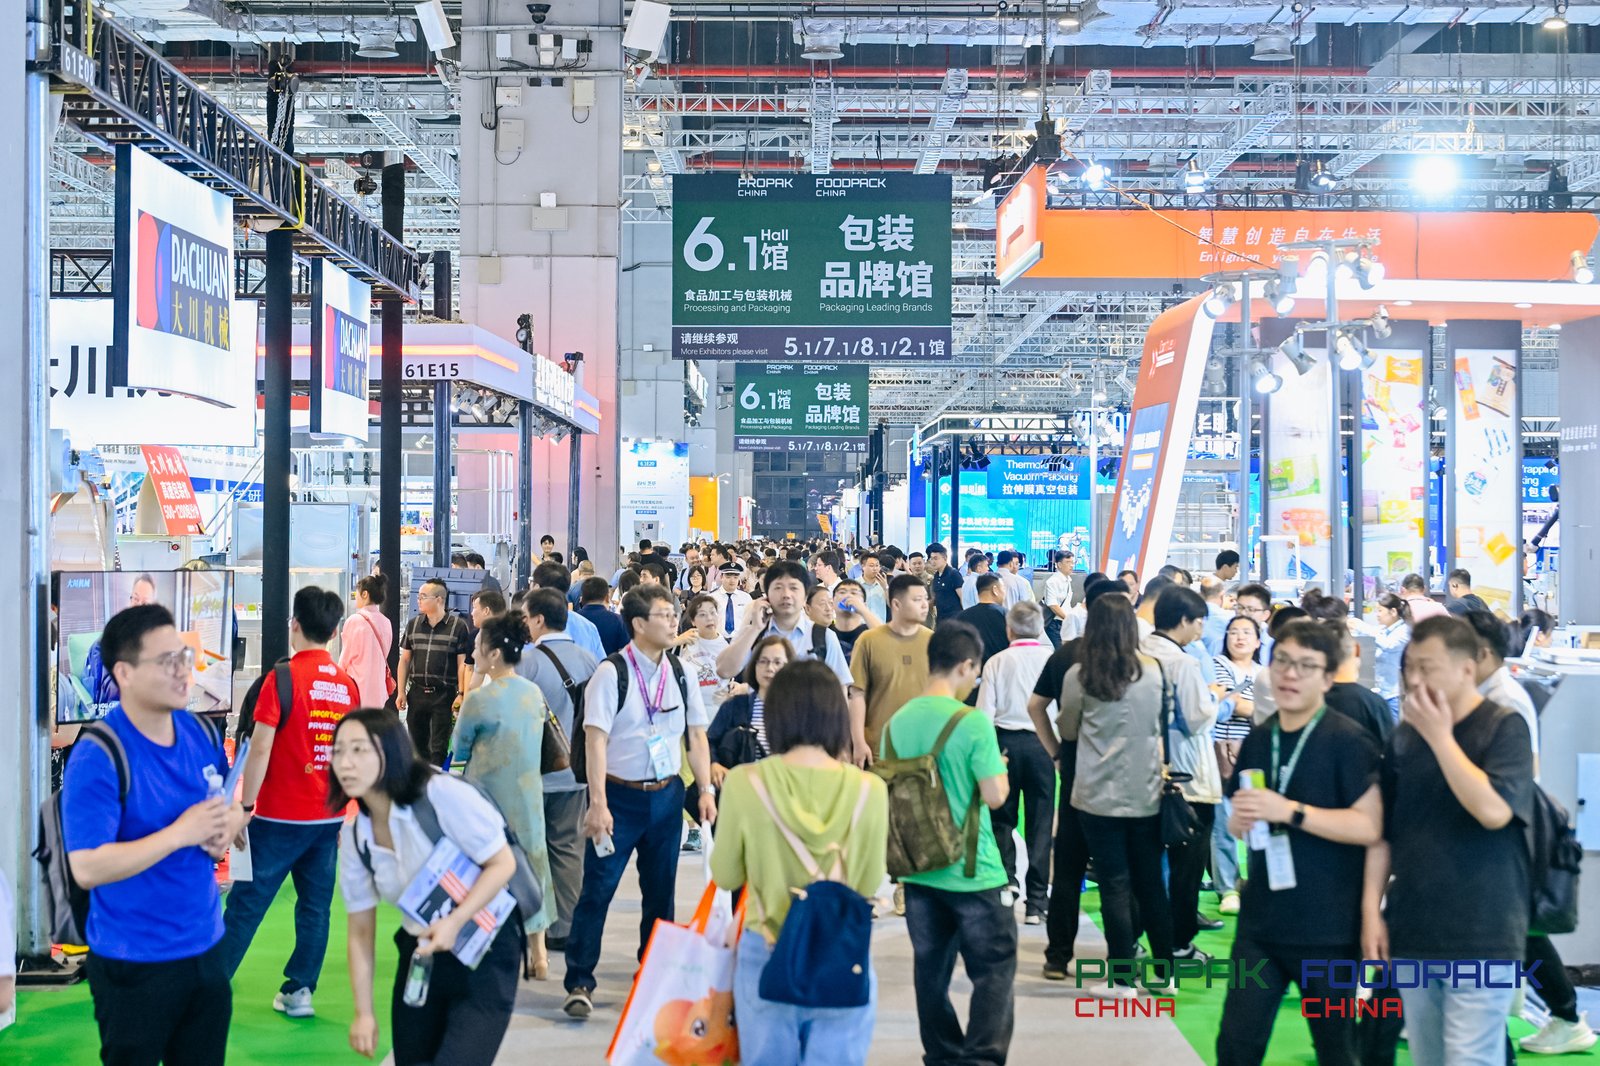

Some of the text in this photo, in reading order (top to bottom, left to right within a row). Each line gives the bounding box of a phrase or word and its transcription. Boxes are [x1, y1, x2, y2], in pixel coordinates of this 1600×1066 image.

[65, 47, 94, 86] 61E08
[738, 178, 793, 188] PROPAK
[816, 178, 886, 188] FOODPACK
[761, 229, 789, 241] Hall
[839, 214, 914, 252] 包装
[683, 216, 757, 272] 6.1
[761, 242, 788, 271] 馆
[1199, 251, 1260, 263] Enlighten
[171, 233, 228, 301] DACHUAN
[820, 261, 933, 298] 品牌馆
[684, 289, 792, 302] 食品加工与包装机械
[683, 303, 791, 313] Processing and Packaging
[820, 303, 933, 313] Packaging Leading Brands
[171, 290, 229, 350] 大川机械
[340, 317, 367, 363] DACHUAN
[681, 332, 738, 345] 请继续参观
[732, 348, 754, 356] please
[755, 347, 768, 355] visit
[405, 363, 459, 377] 61E15
[740, 382, 776, 410] 6.1
[815, 382, 851, 401] 包装
[777, 396, 791, 410] 馆
[740, 417, 793, 425] 食品加工与包装机械
[805, 405, 860, 424] 品牌馆
[148, 452, 186, 476] 大川机械
[1522, 465, 1558, 475] rapping
[1003, 472, 1078, 483] Vacuum Packing
[1002, 484, 1078, 495] 拉伸膜真空包装
